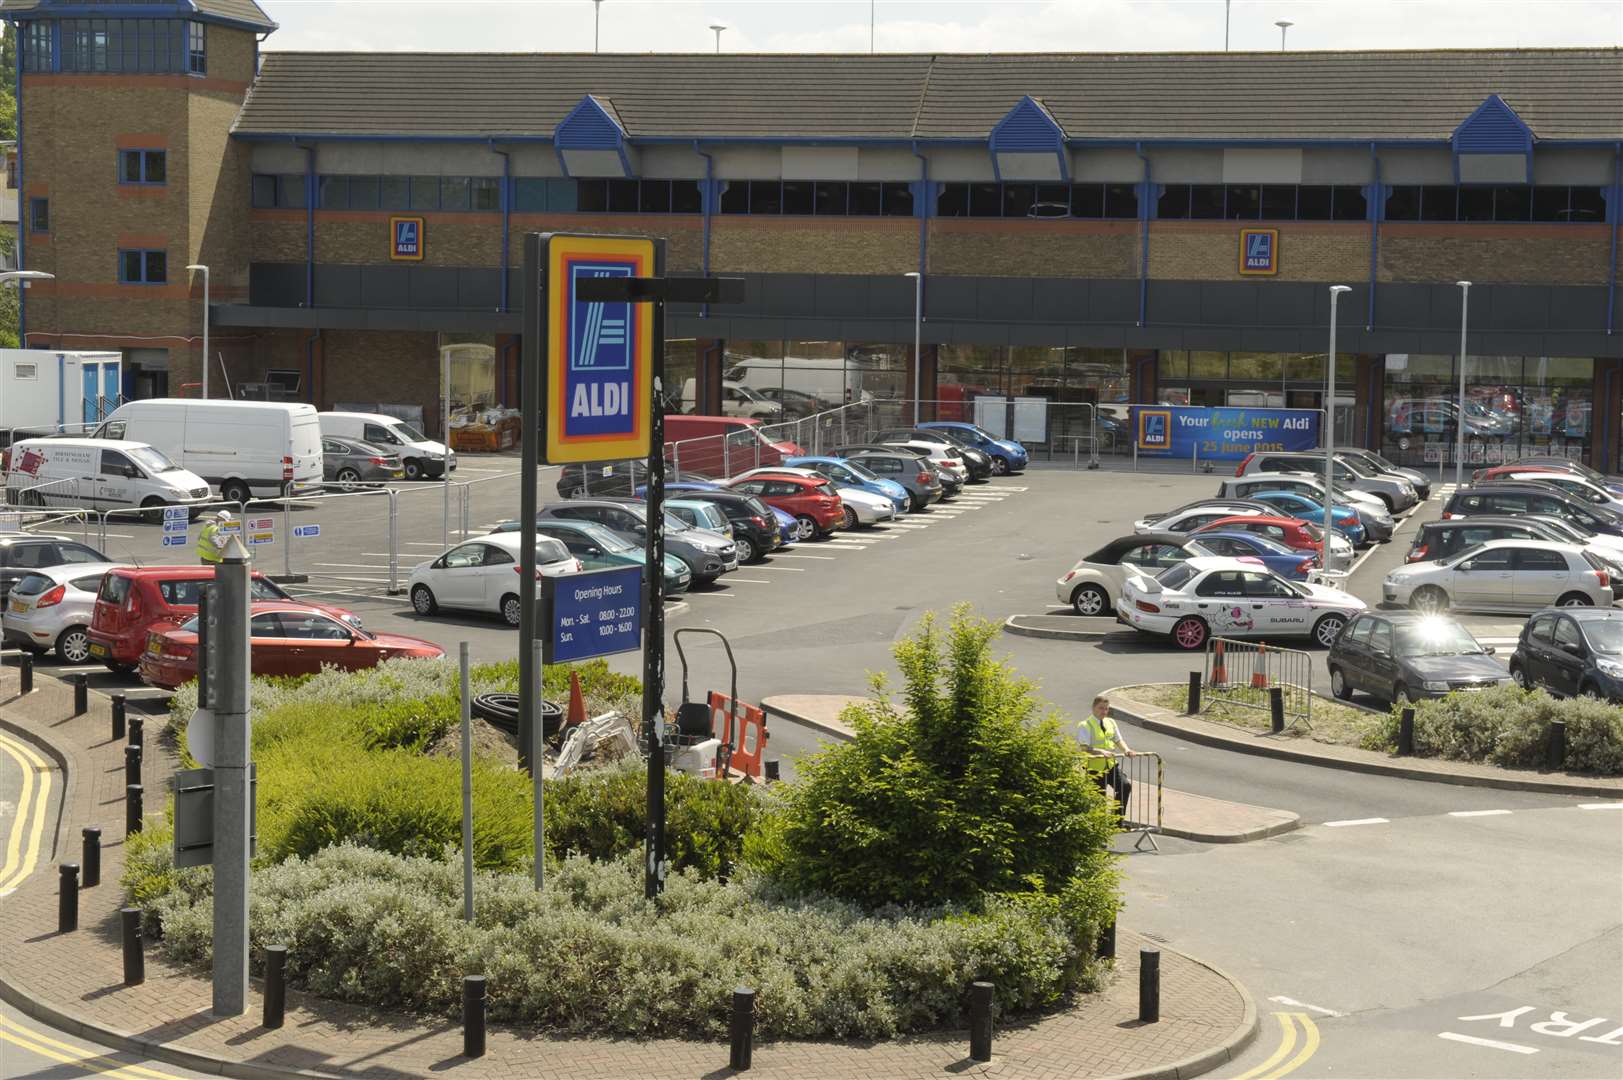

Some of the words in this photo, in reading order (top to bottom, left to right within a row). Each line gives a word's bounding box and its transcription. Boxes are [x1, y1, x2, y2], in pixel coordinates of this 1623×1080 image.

[398, 244, 416, 252] ALDI
[571, 381, 629, 418] ALDI
[1179, 415, 1209, 427] Your
[1251, 418, 1279, 429] NEW
[1283, 417, 1310, 430] Aldi
[1145, 434, 1165, 442] ALDI
[1224, 430, 1263, 442] opens
[1202, 441, 1217, 452] 25
[575, 587, 603, 601] Opening
[603, 585, 622, 595] Hours
[1456, 1005, 1623, 1046] TRY
